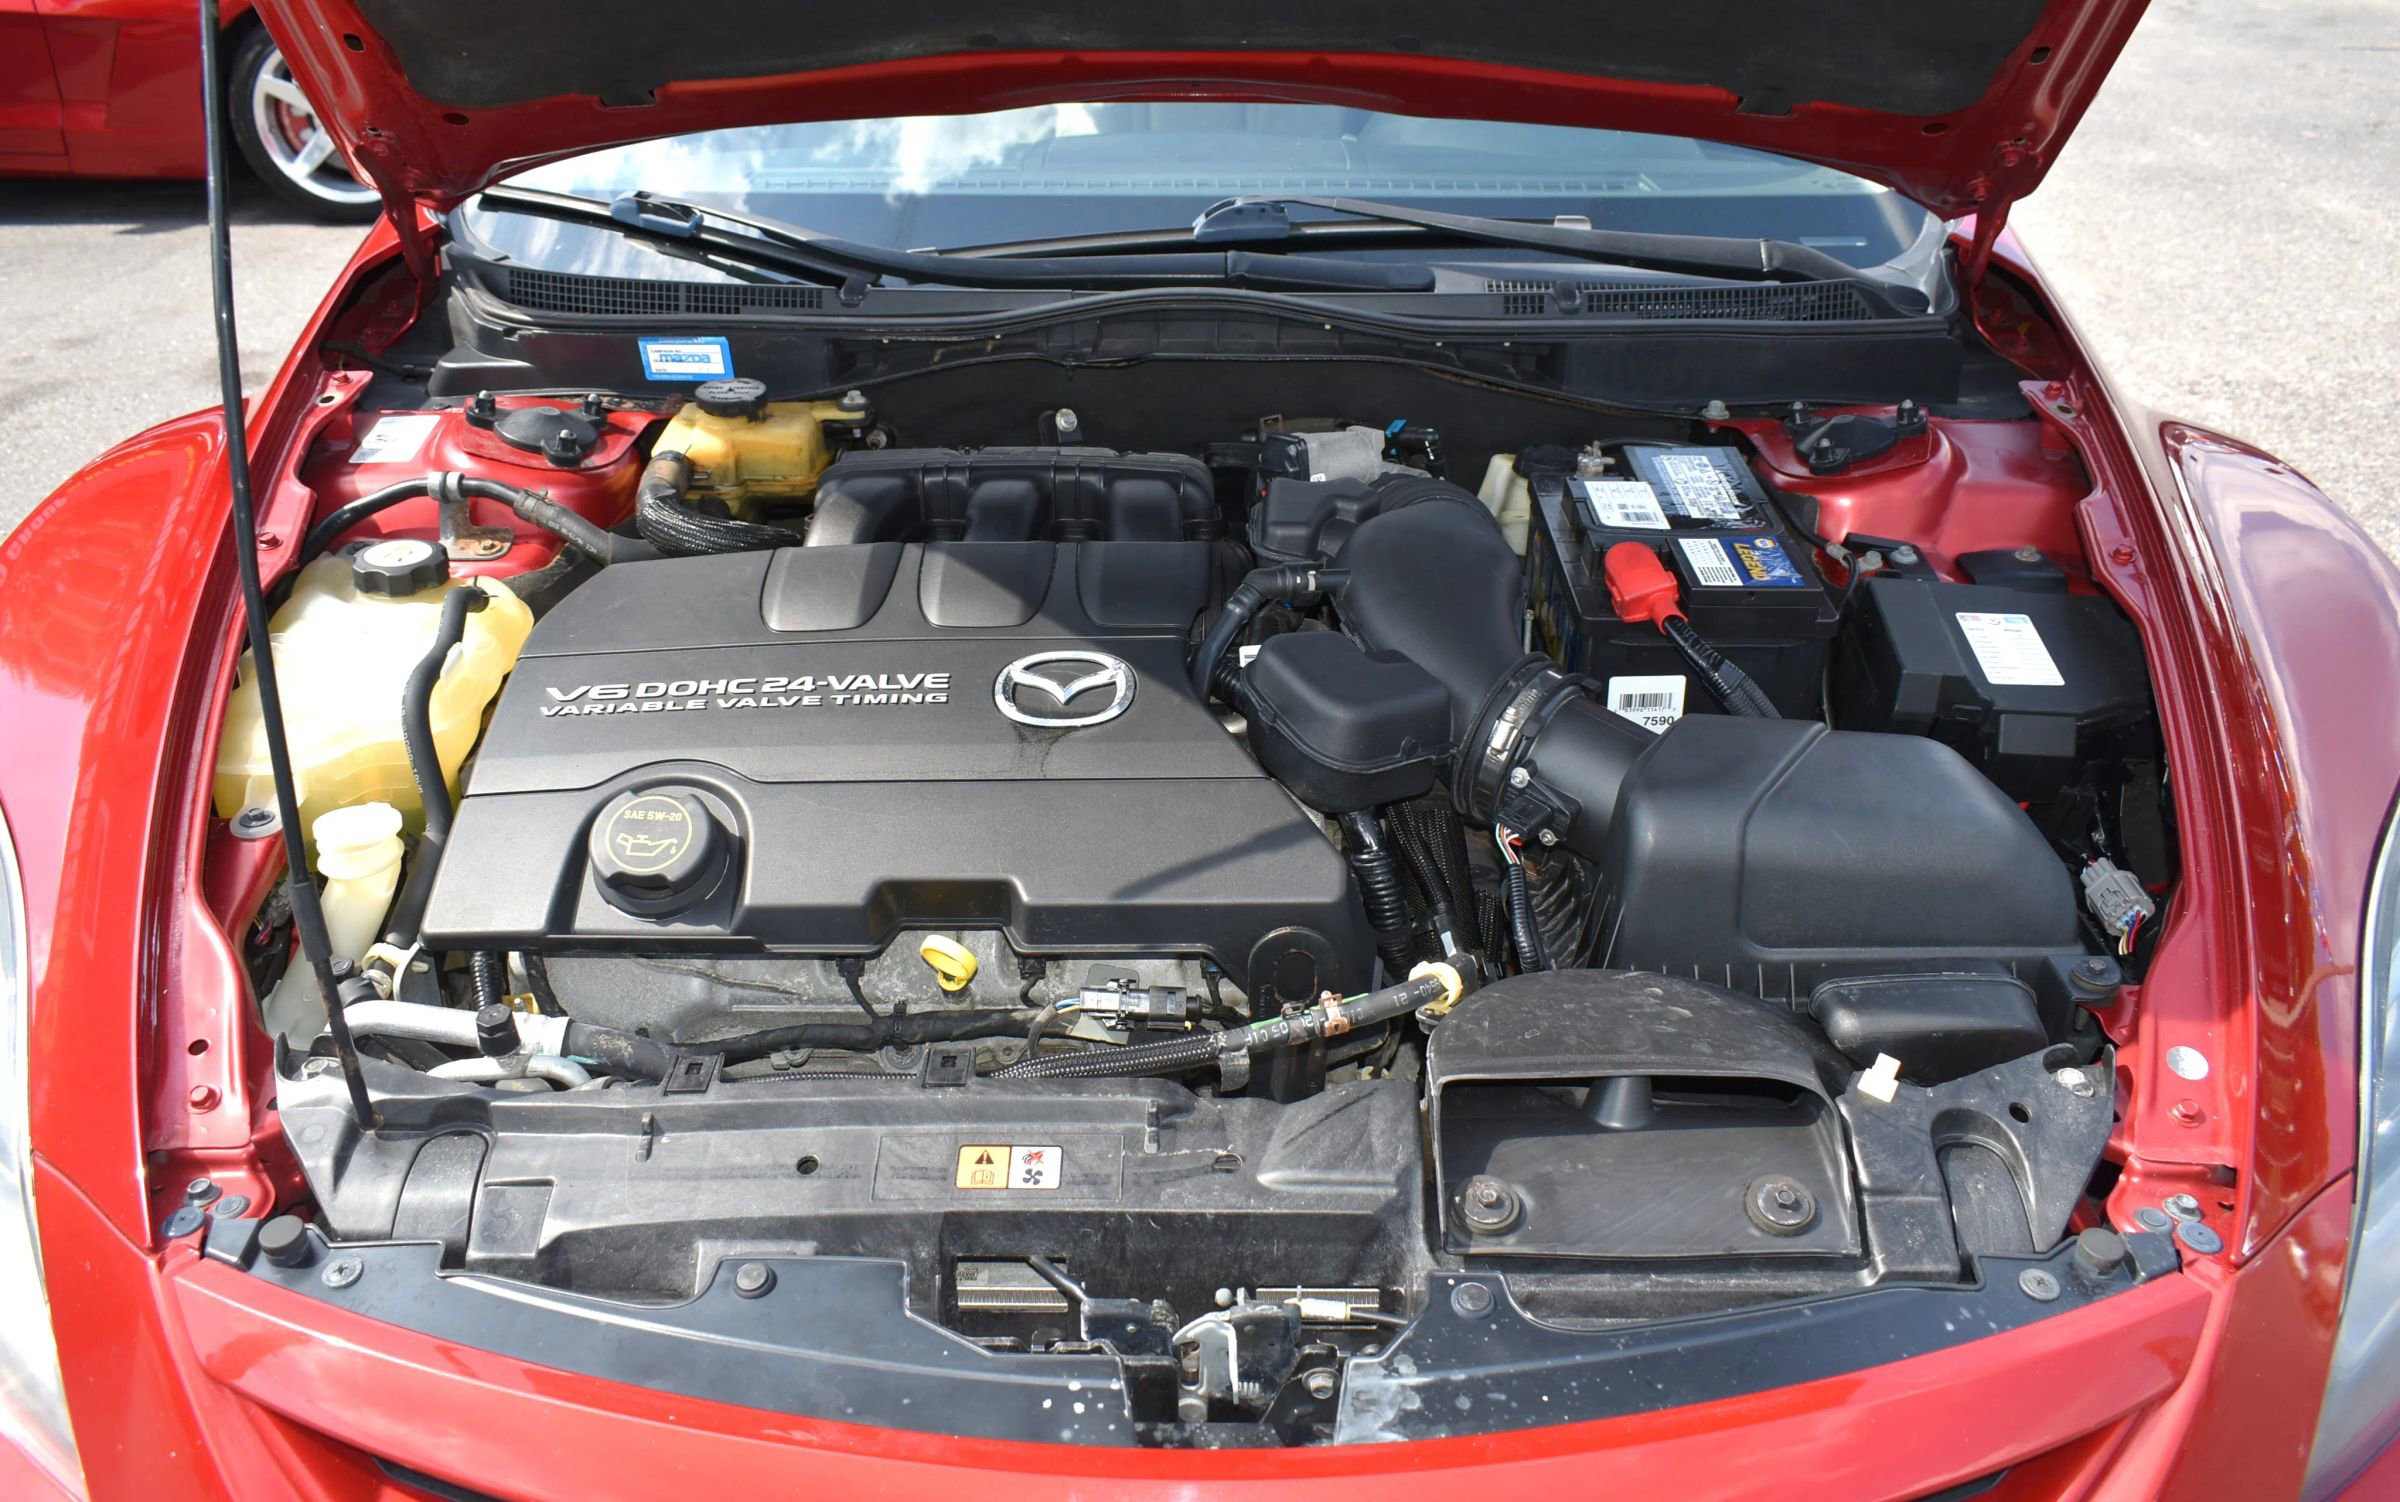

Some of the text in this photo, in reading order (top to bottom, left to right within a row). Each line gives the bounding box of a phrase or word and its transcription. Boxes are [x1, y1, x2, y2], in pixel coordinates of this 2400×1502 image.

[1733, 543, 1772, 582] LEGEND
[546, 672, 951, 702] V6 DOHC 24-VALVE
[540, 692, 950, 717] VARIABLE VALVE TIMING
[1642, 715, 1675, 727] 7590
[623, 810, 682, 822] SAE 5W-20
